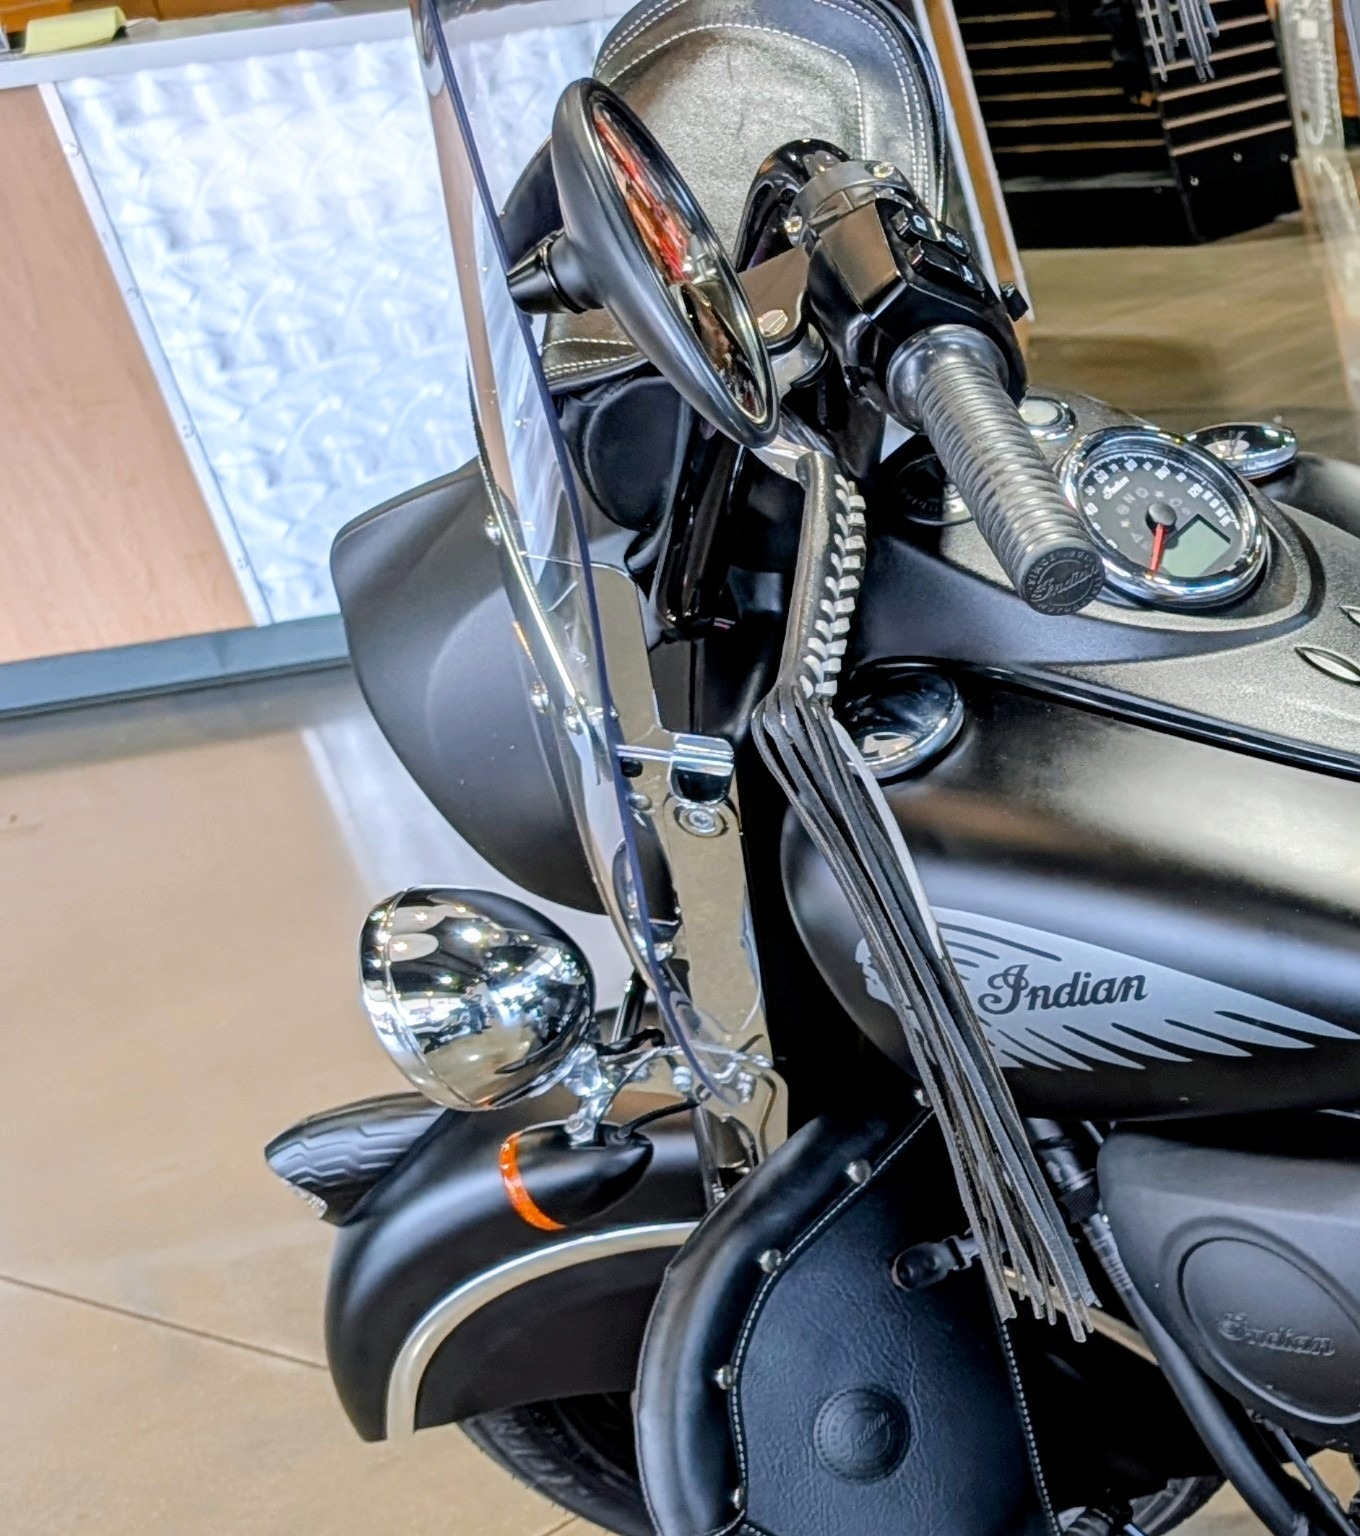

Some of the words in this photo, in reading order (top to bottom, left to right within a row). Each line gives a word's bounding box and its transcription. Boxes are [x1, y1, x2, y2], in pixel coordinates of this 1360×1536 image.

[1187, 483, 1204, 499] 120
[978, 964, 1149, 1015] Indian
[1216, 1311, 1336, 1357] Indian
